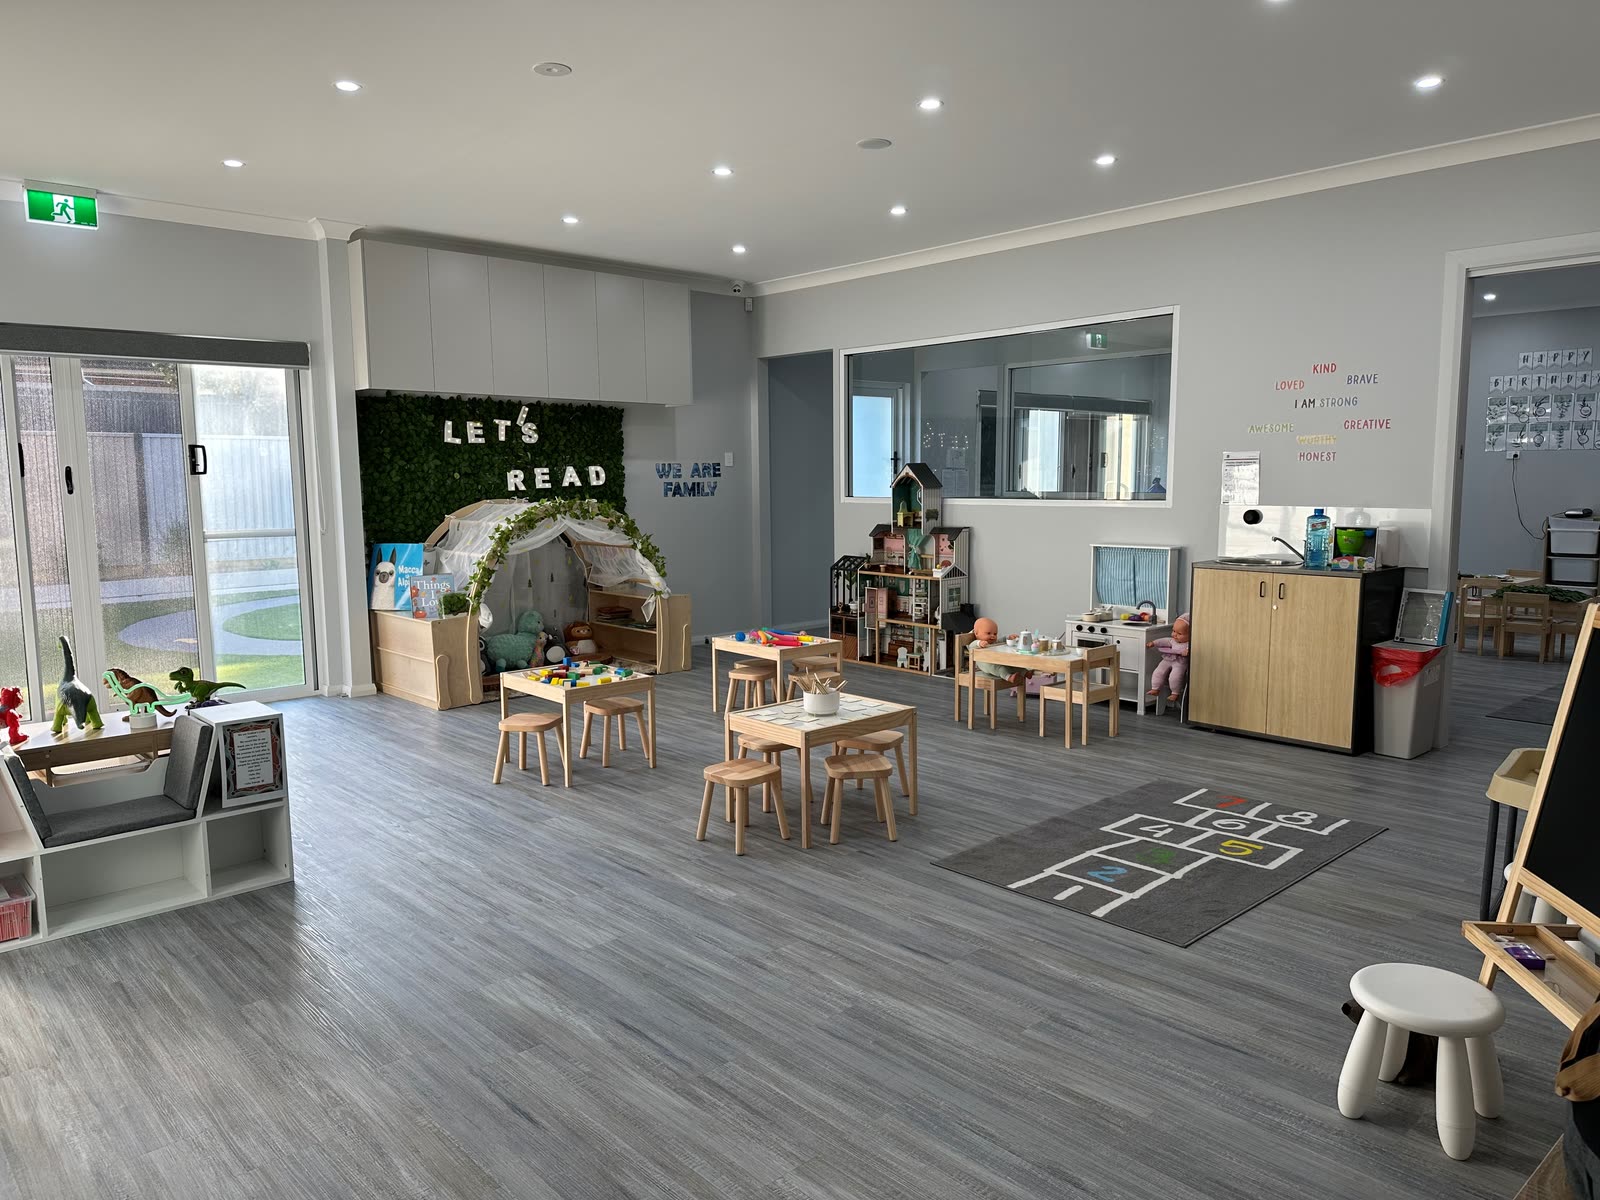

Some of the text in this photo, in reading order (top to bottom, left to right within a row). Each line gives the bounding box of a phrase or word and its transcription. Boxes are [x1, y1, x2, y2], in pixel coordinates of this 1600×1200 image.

[1312, 363, 1337, 374] KIND
[1275, 380, 1305, 390] LOVED
[1346, 373, 1379, 385] BRAVE
[1294, 396, 1358, 409] I AM STRONG
[1248, 423, 1294, 434] AWESOME
[1343, 419, 1391, 430] CREATIVE
[1298, 451, 1337, 462] HONEST
[655, 462, 722, 479] WE ARE
[507, 466, 606, 491] READ
[663, 481, 717, 497] FAMILY
[414, 580, 451, 592] Things
[431, 590, 435, 599] I
[1216, 795, 1247, 808] 7
[1212, 818, 1250, 830] 6
[1275, 811, 1318, 825] 8
[1139, 824, 1174, 838] 4
[1219, 840, 1263, 856] 5
[1087, 865, 1128, 882] 2
